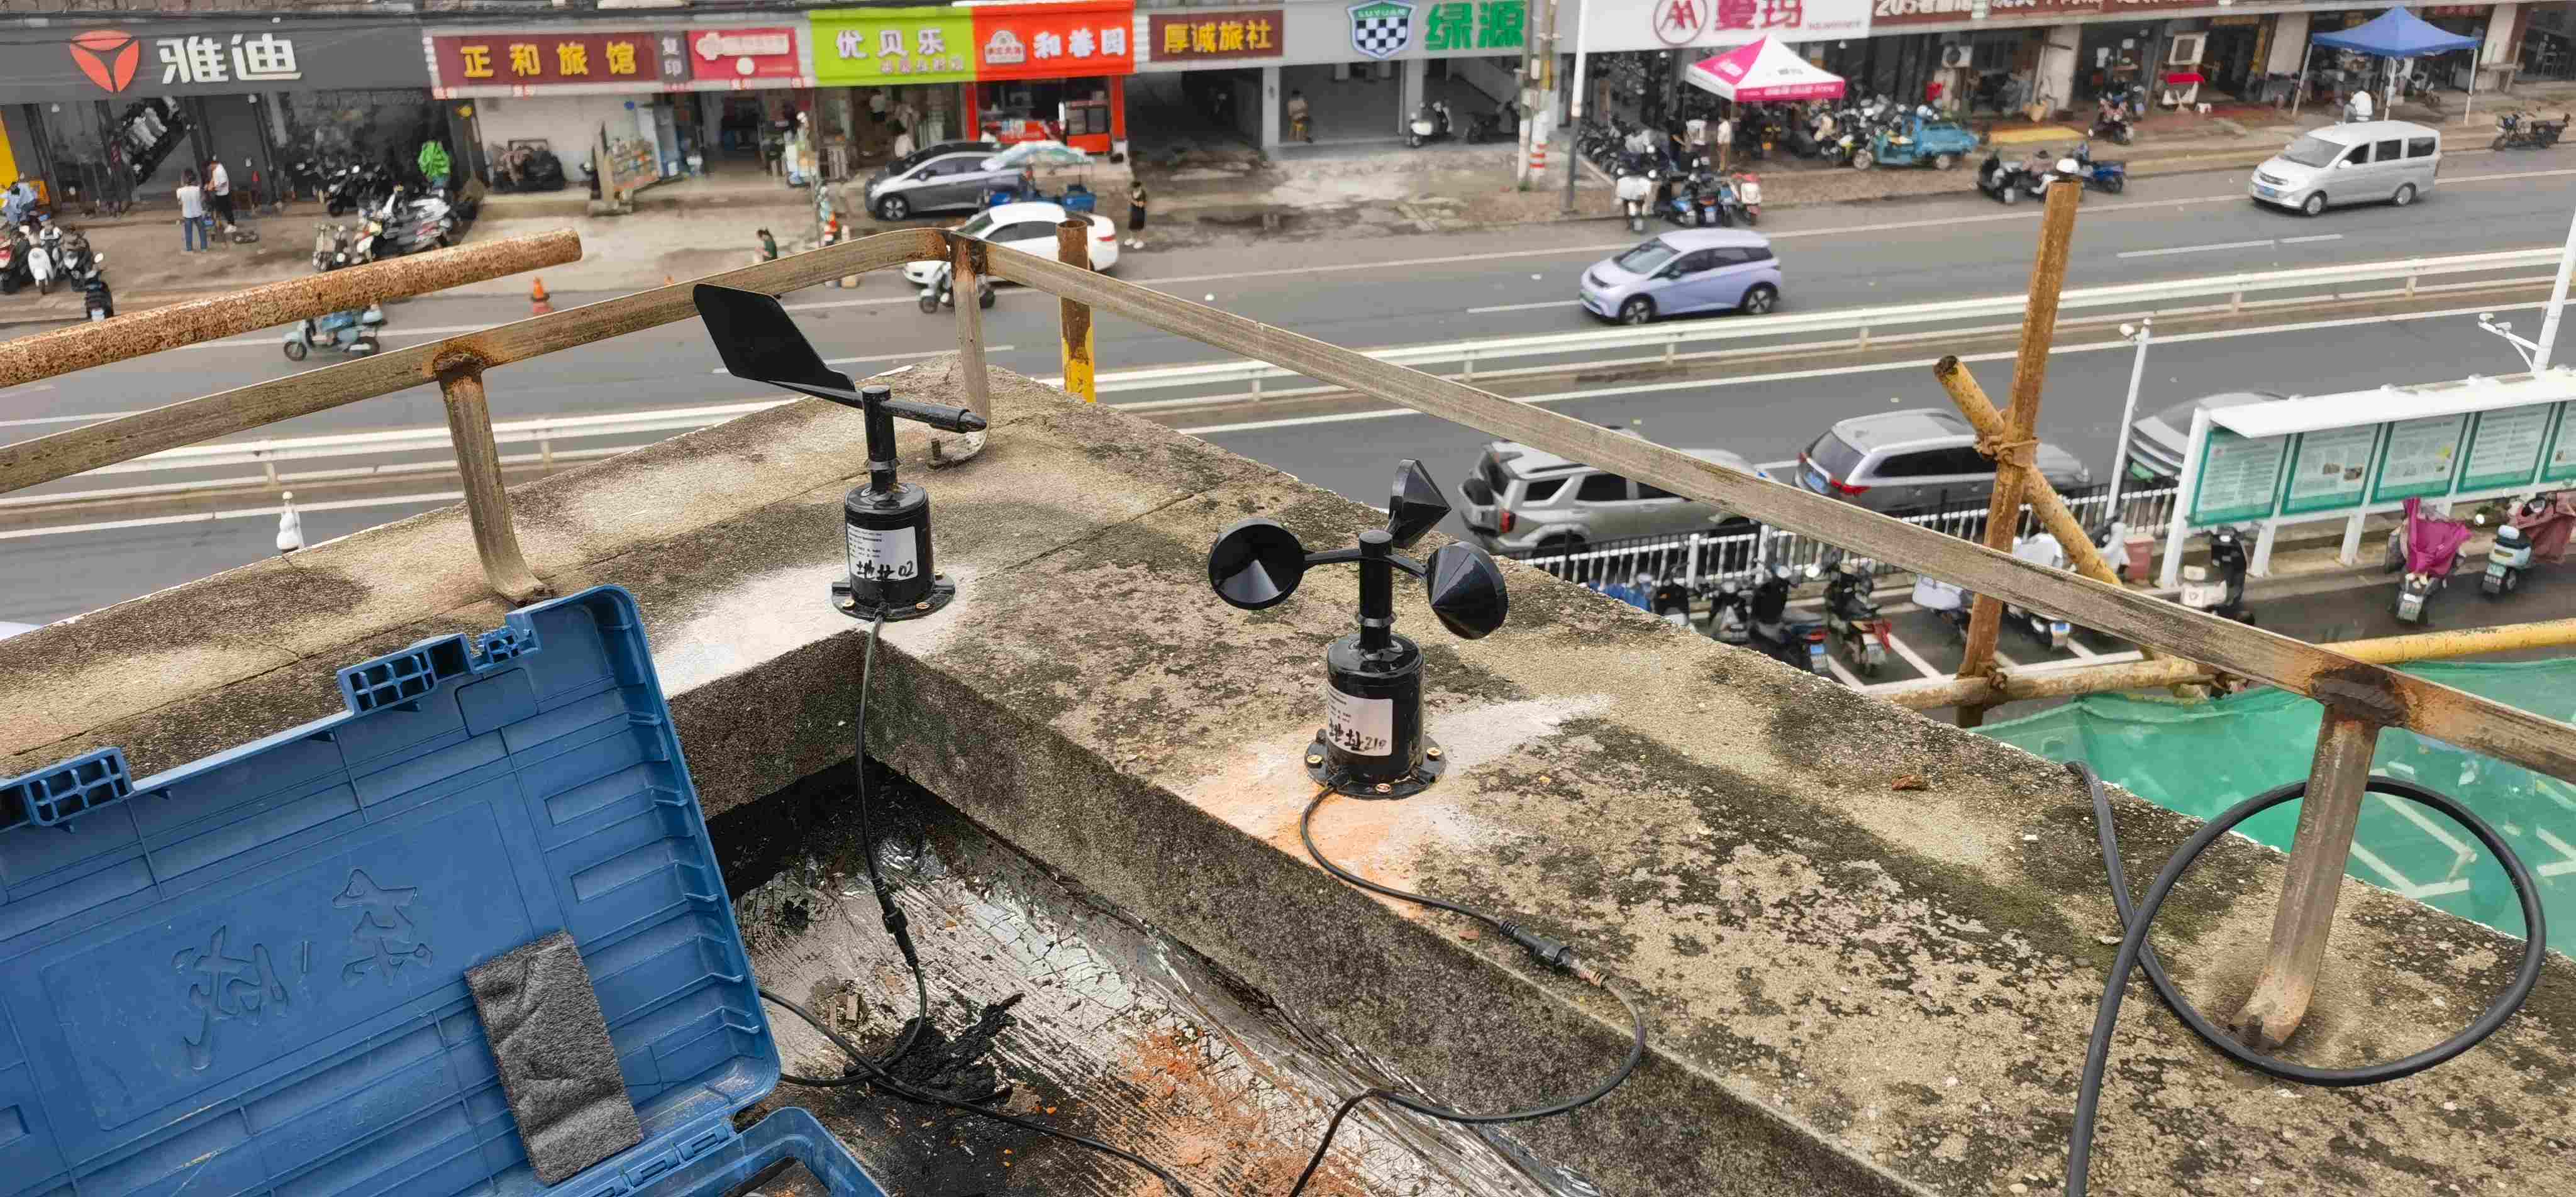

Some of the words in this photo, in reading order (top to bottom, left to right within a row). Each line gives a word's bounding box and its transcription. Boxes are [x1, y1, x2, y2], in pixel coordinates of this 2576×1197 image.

[836, 28, 945, 59] 优贝乐
[1163, 19, 1274, 53] 厚诚旅社
[1425, 1, 1526, 50] 绿源
[157, 33, 302, 84] 雅迪
[460, 41, 637, 79] 正和旅馆
